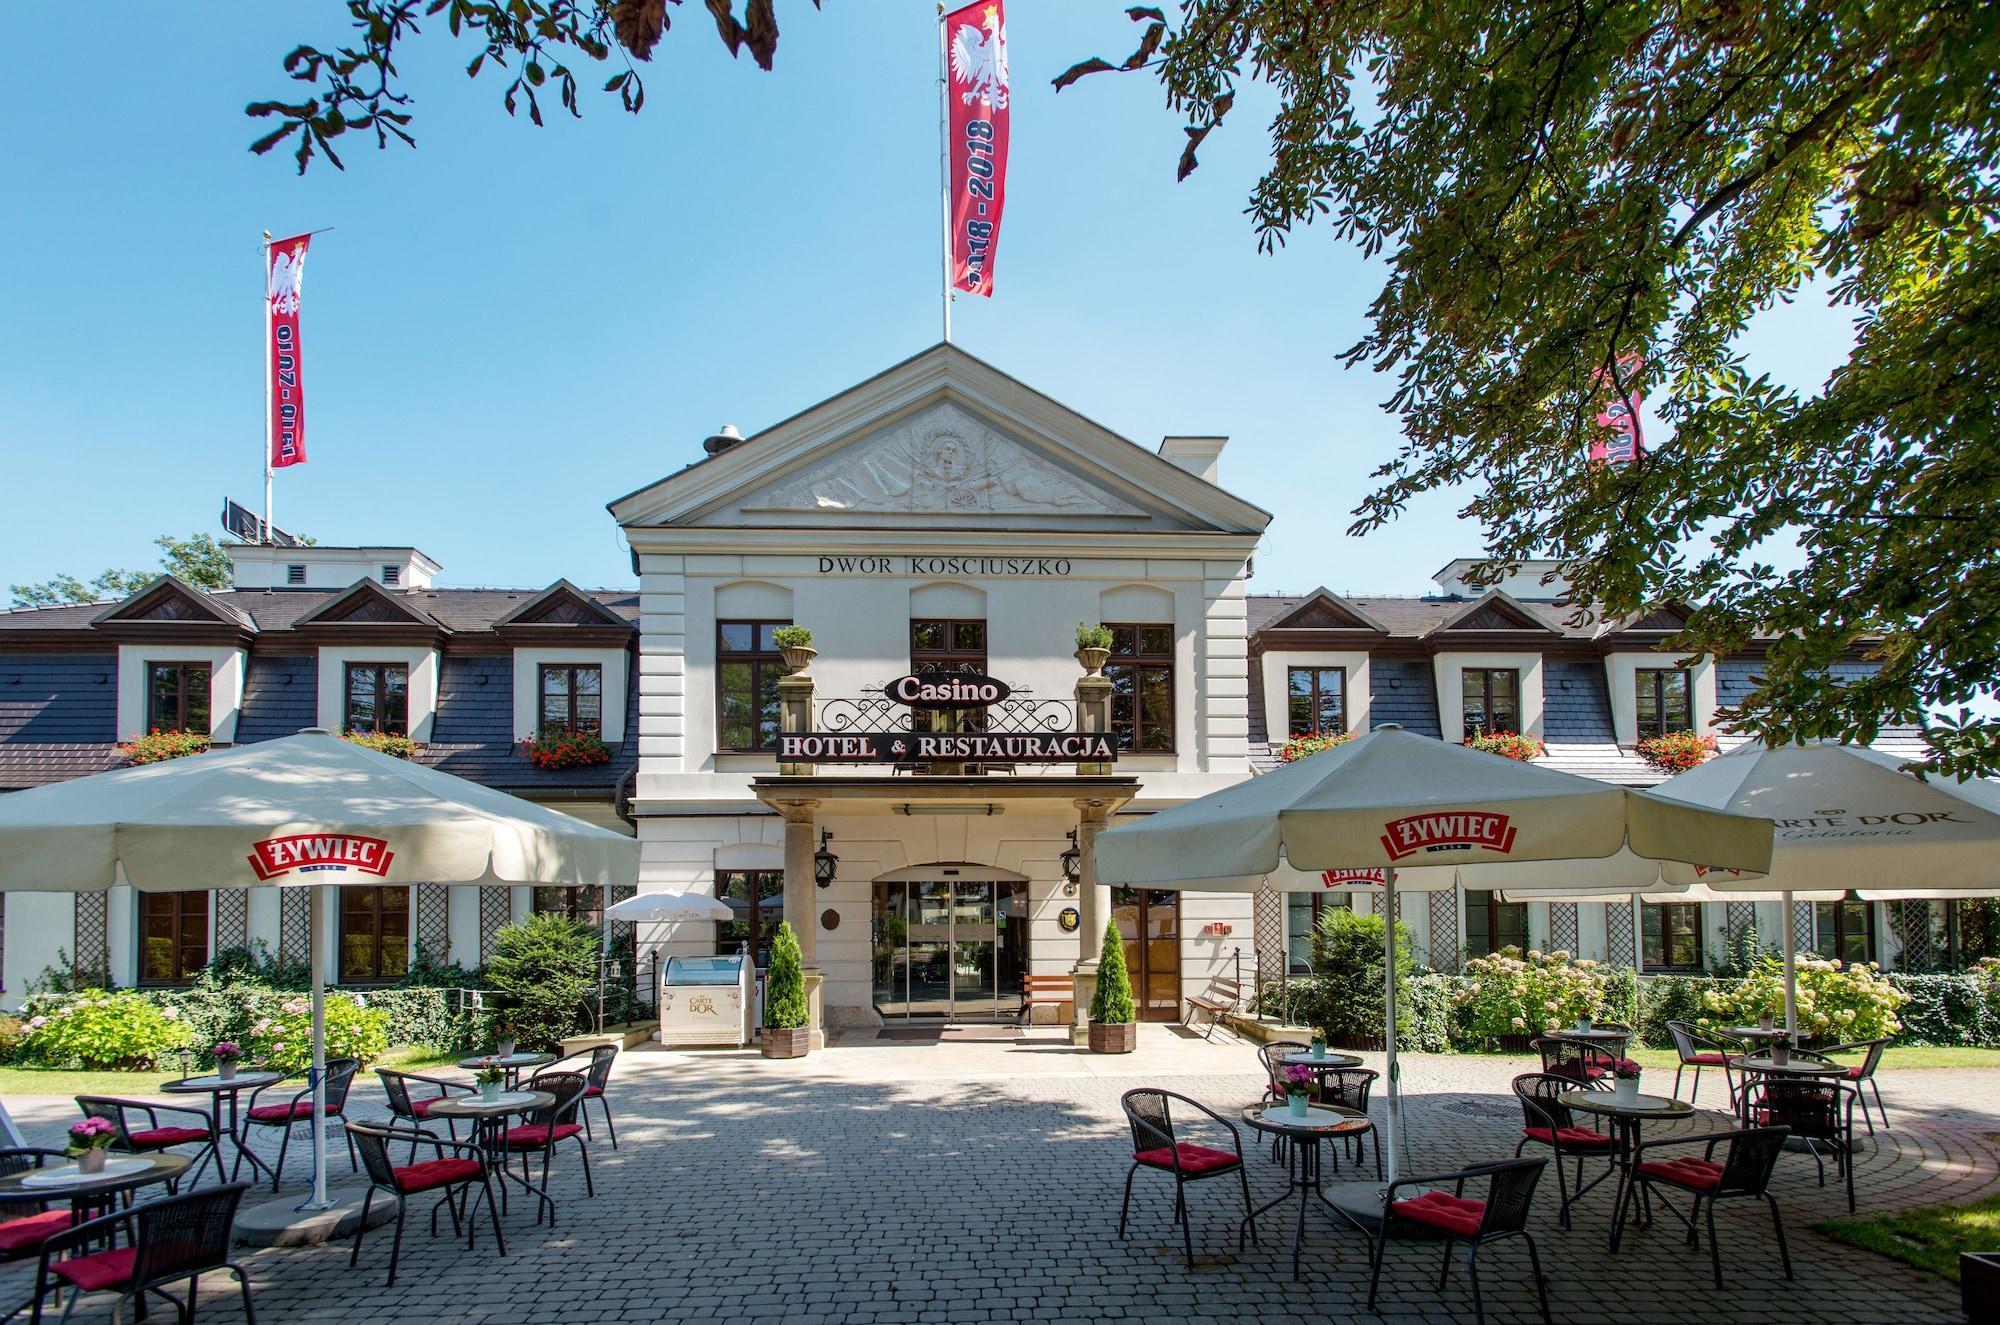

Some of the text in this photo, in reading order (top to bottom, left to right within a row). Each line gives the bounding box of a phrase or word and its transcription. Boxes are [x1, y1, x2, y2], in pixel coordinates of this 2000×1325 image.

[966, 120, 994, 200] 2018
[819, 556, 1071, 575] DWÓR KOŚCIUSZKO
[897, 676, 998, 701] Casino
[781, 736, 1113, 758] HOTEL & RESTAURACJA
[1397, 815, 1499, 846] ŻYWIEC
[1775, 812, 1976, 828] RTE D'OR
[266, 838, 377, 866] ŻYWIEC
